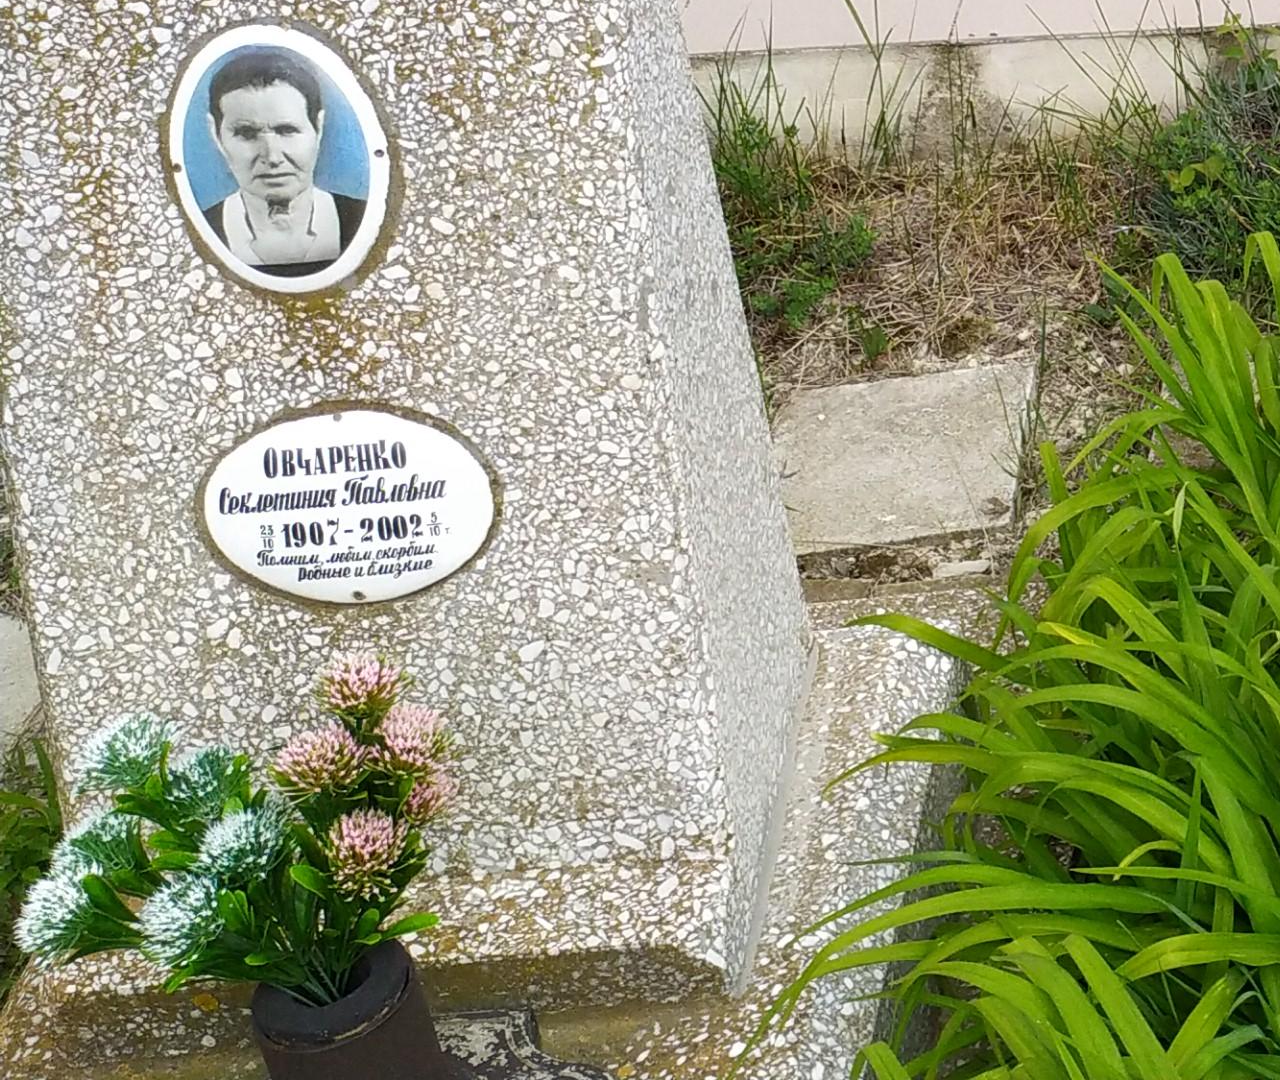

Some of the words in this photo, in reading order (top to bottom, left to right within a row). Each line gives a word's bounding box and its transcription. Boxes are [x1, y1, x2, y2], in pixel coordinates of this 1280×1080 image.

[263, 440, 407, 479] ОВЧАРЕНКО
[219, 487, 337, 515] Секлетиния
[342, 475, 447, 507] Павловна
[298, 564, 351, 582] Родные
[367, 559, 433, 579] близкие
